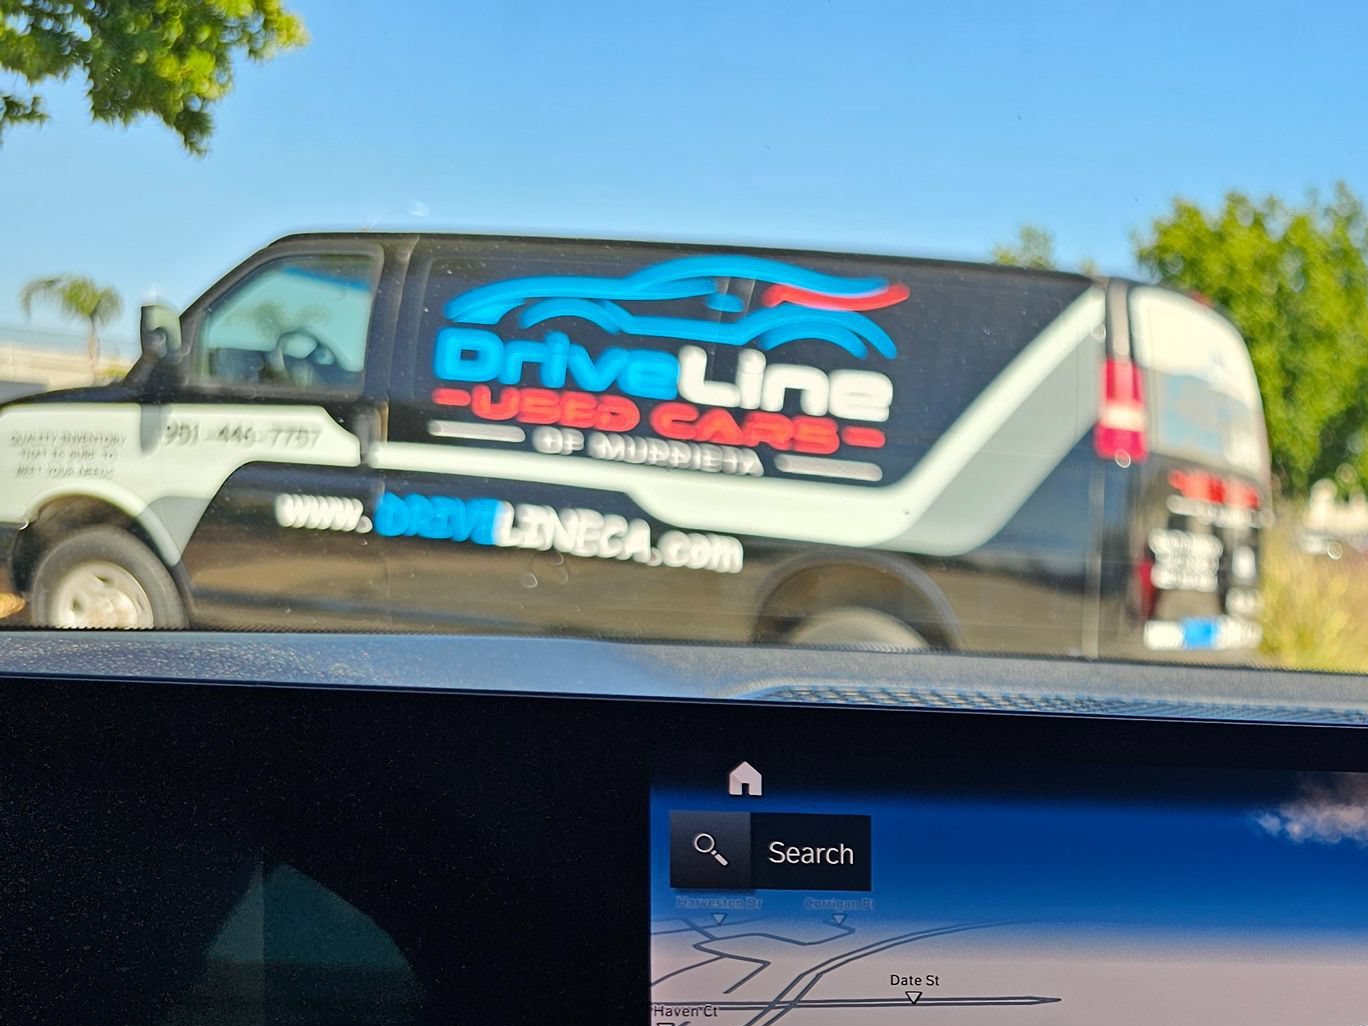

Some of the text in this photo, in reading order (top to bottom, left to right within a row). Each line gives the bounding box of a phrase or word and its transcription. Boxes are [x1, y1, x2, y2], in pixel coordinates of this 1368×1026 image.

[432, 326, 894, 422] DriveLine
[471, 385, 840, 454] USED CARS
[532, 426, 584, 455] OF
[768, 841, 854, 866] Search
[890, 974, 940, 987] Date St
[654, 1004, 718, 1018] Haven Ct
